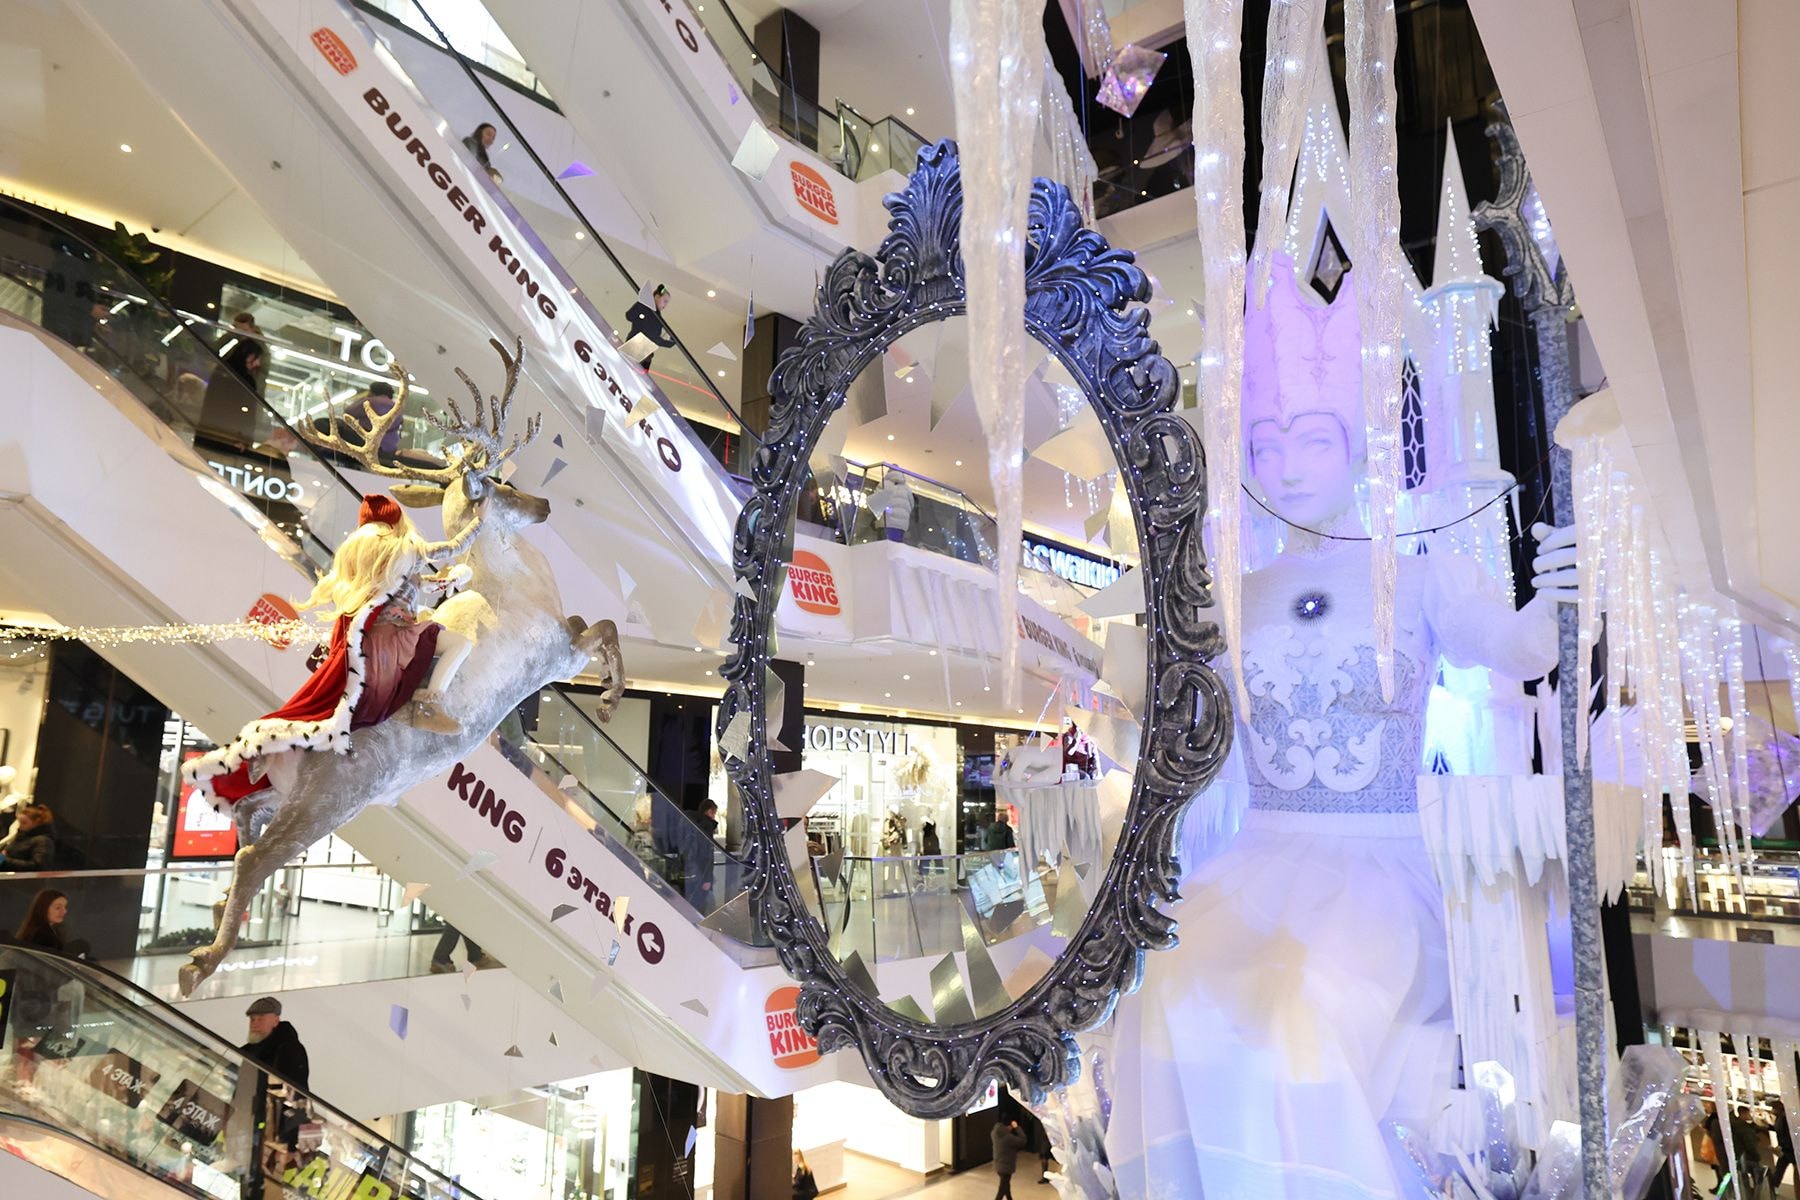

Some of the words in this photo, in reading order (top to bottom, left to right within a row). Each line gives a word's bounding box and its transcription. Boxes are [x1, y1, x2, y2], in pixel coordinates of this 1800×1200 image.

[312, 31, 349, 74] KING
[791, 170, 835, 204] BURGER
[793, 181, 837, 218] KING
[363, 87, 486, 235] BURGER
[488, 235, 558, 320] KING
[574, 339, 593, 363] 6
[788, 566, 835, 588] BURGER
[791, 580, 839, 606] KING
[447, 762, 526, 843] KING
[545, 848, 566, 878] 6
[766, 1012, 798, 1032] BUR
[110, 1067, 147, 1095] ЭТАЖ
[172, 1096, 185, 1110] 4
[182, 1100, 222, 1131] ЭТАЖ
